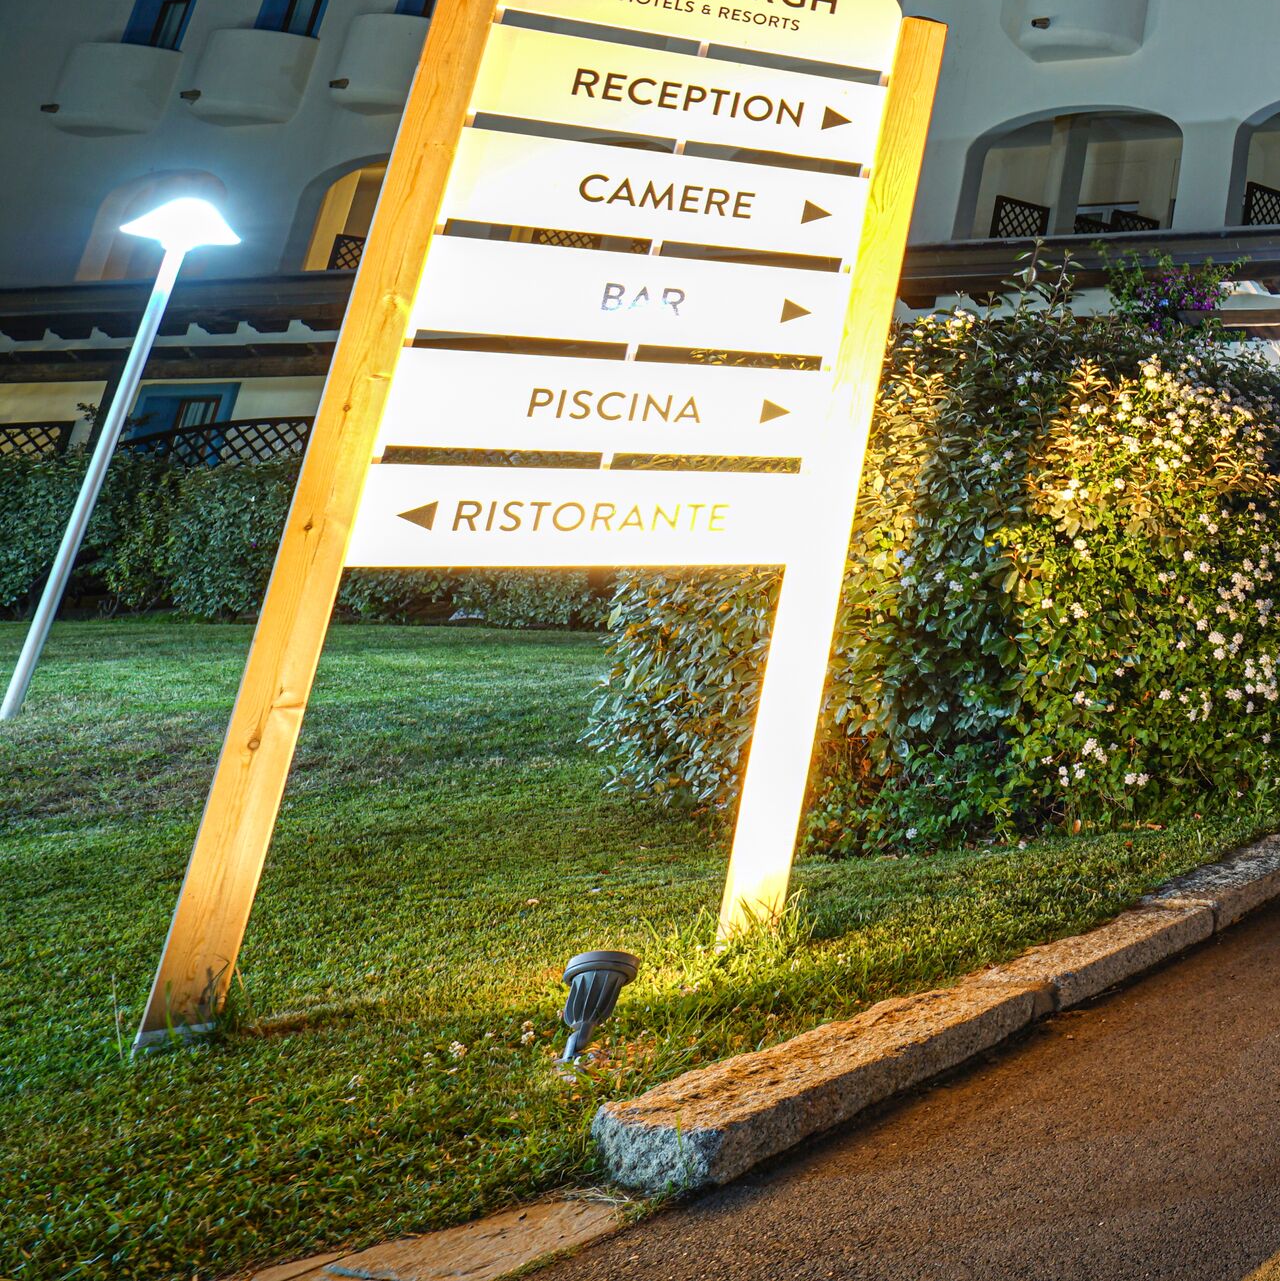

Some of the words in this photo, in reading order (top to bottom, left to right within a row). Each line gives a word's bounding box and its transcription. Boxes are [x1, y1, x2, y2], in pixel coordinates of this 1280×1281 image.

[701, 4, 712, 16] &
[718, 5, 801, 32] RESORTS
[570, 68, 805, 127] RECEPTION
[579, 173, 756, 220] CAMERE
[601, 283, 686, 316] BAR
[526, 388, 701, 424] PISCINA
[451, 501, 730, 532] RISTORANTE
